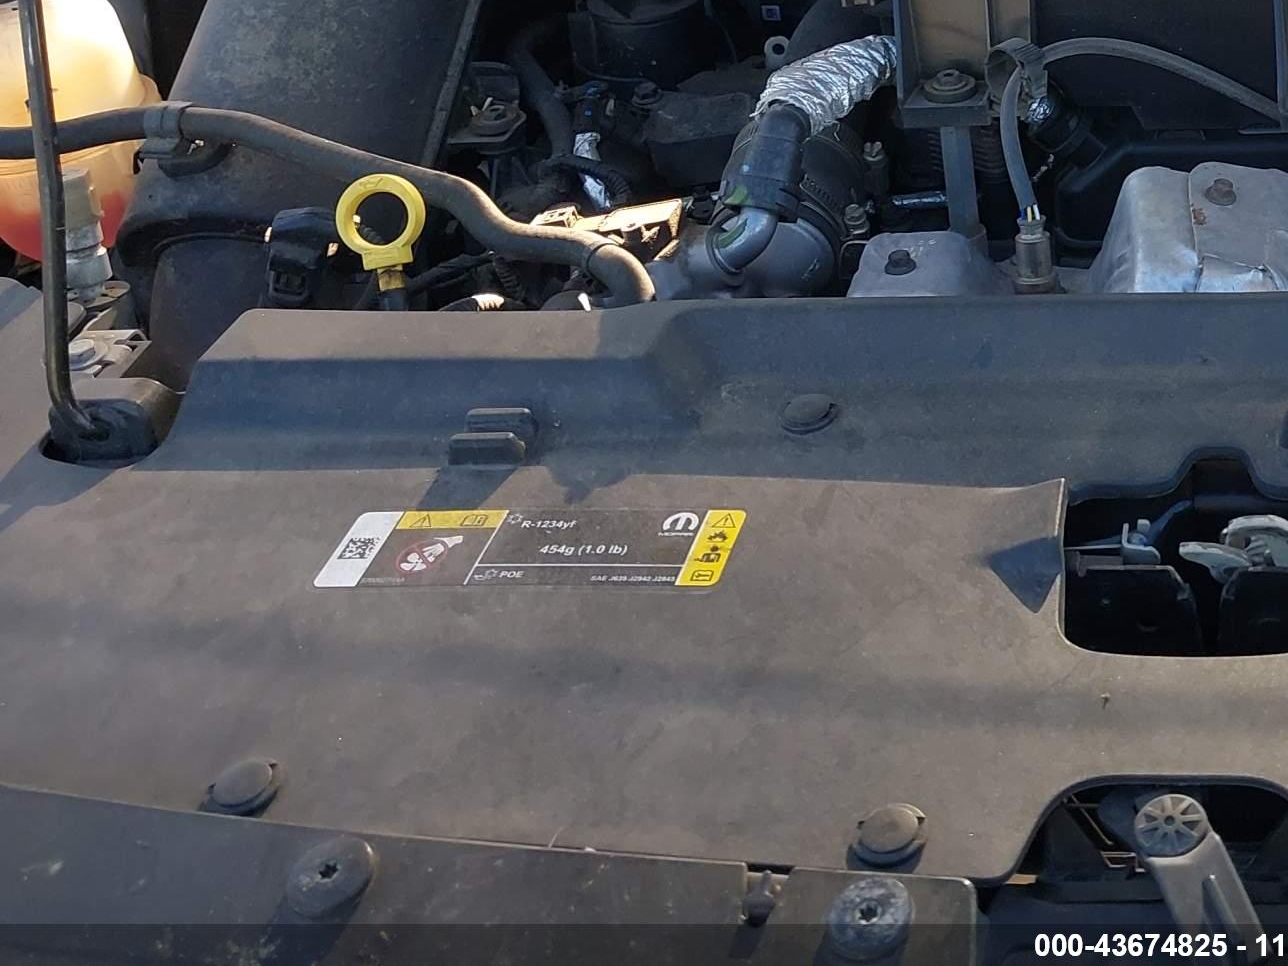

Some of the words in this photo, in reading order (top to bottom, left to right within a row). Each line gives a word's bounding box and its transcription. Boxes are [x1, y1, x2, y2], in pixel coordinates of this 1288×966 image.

[521, 520, 577, 530] R-1234yf
[539, 544, 575, 556] 454g
[578, 544, 606, 556] (1.0
[608, 544, 628, 556] lb)
[498, 570, 524, 579] POE
